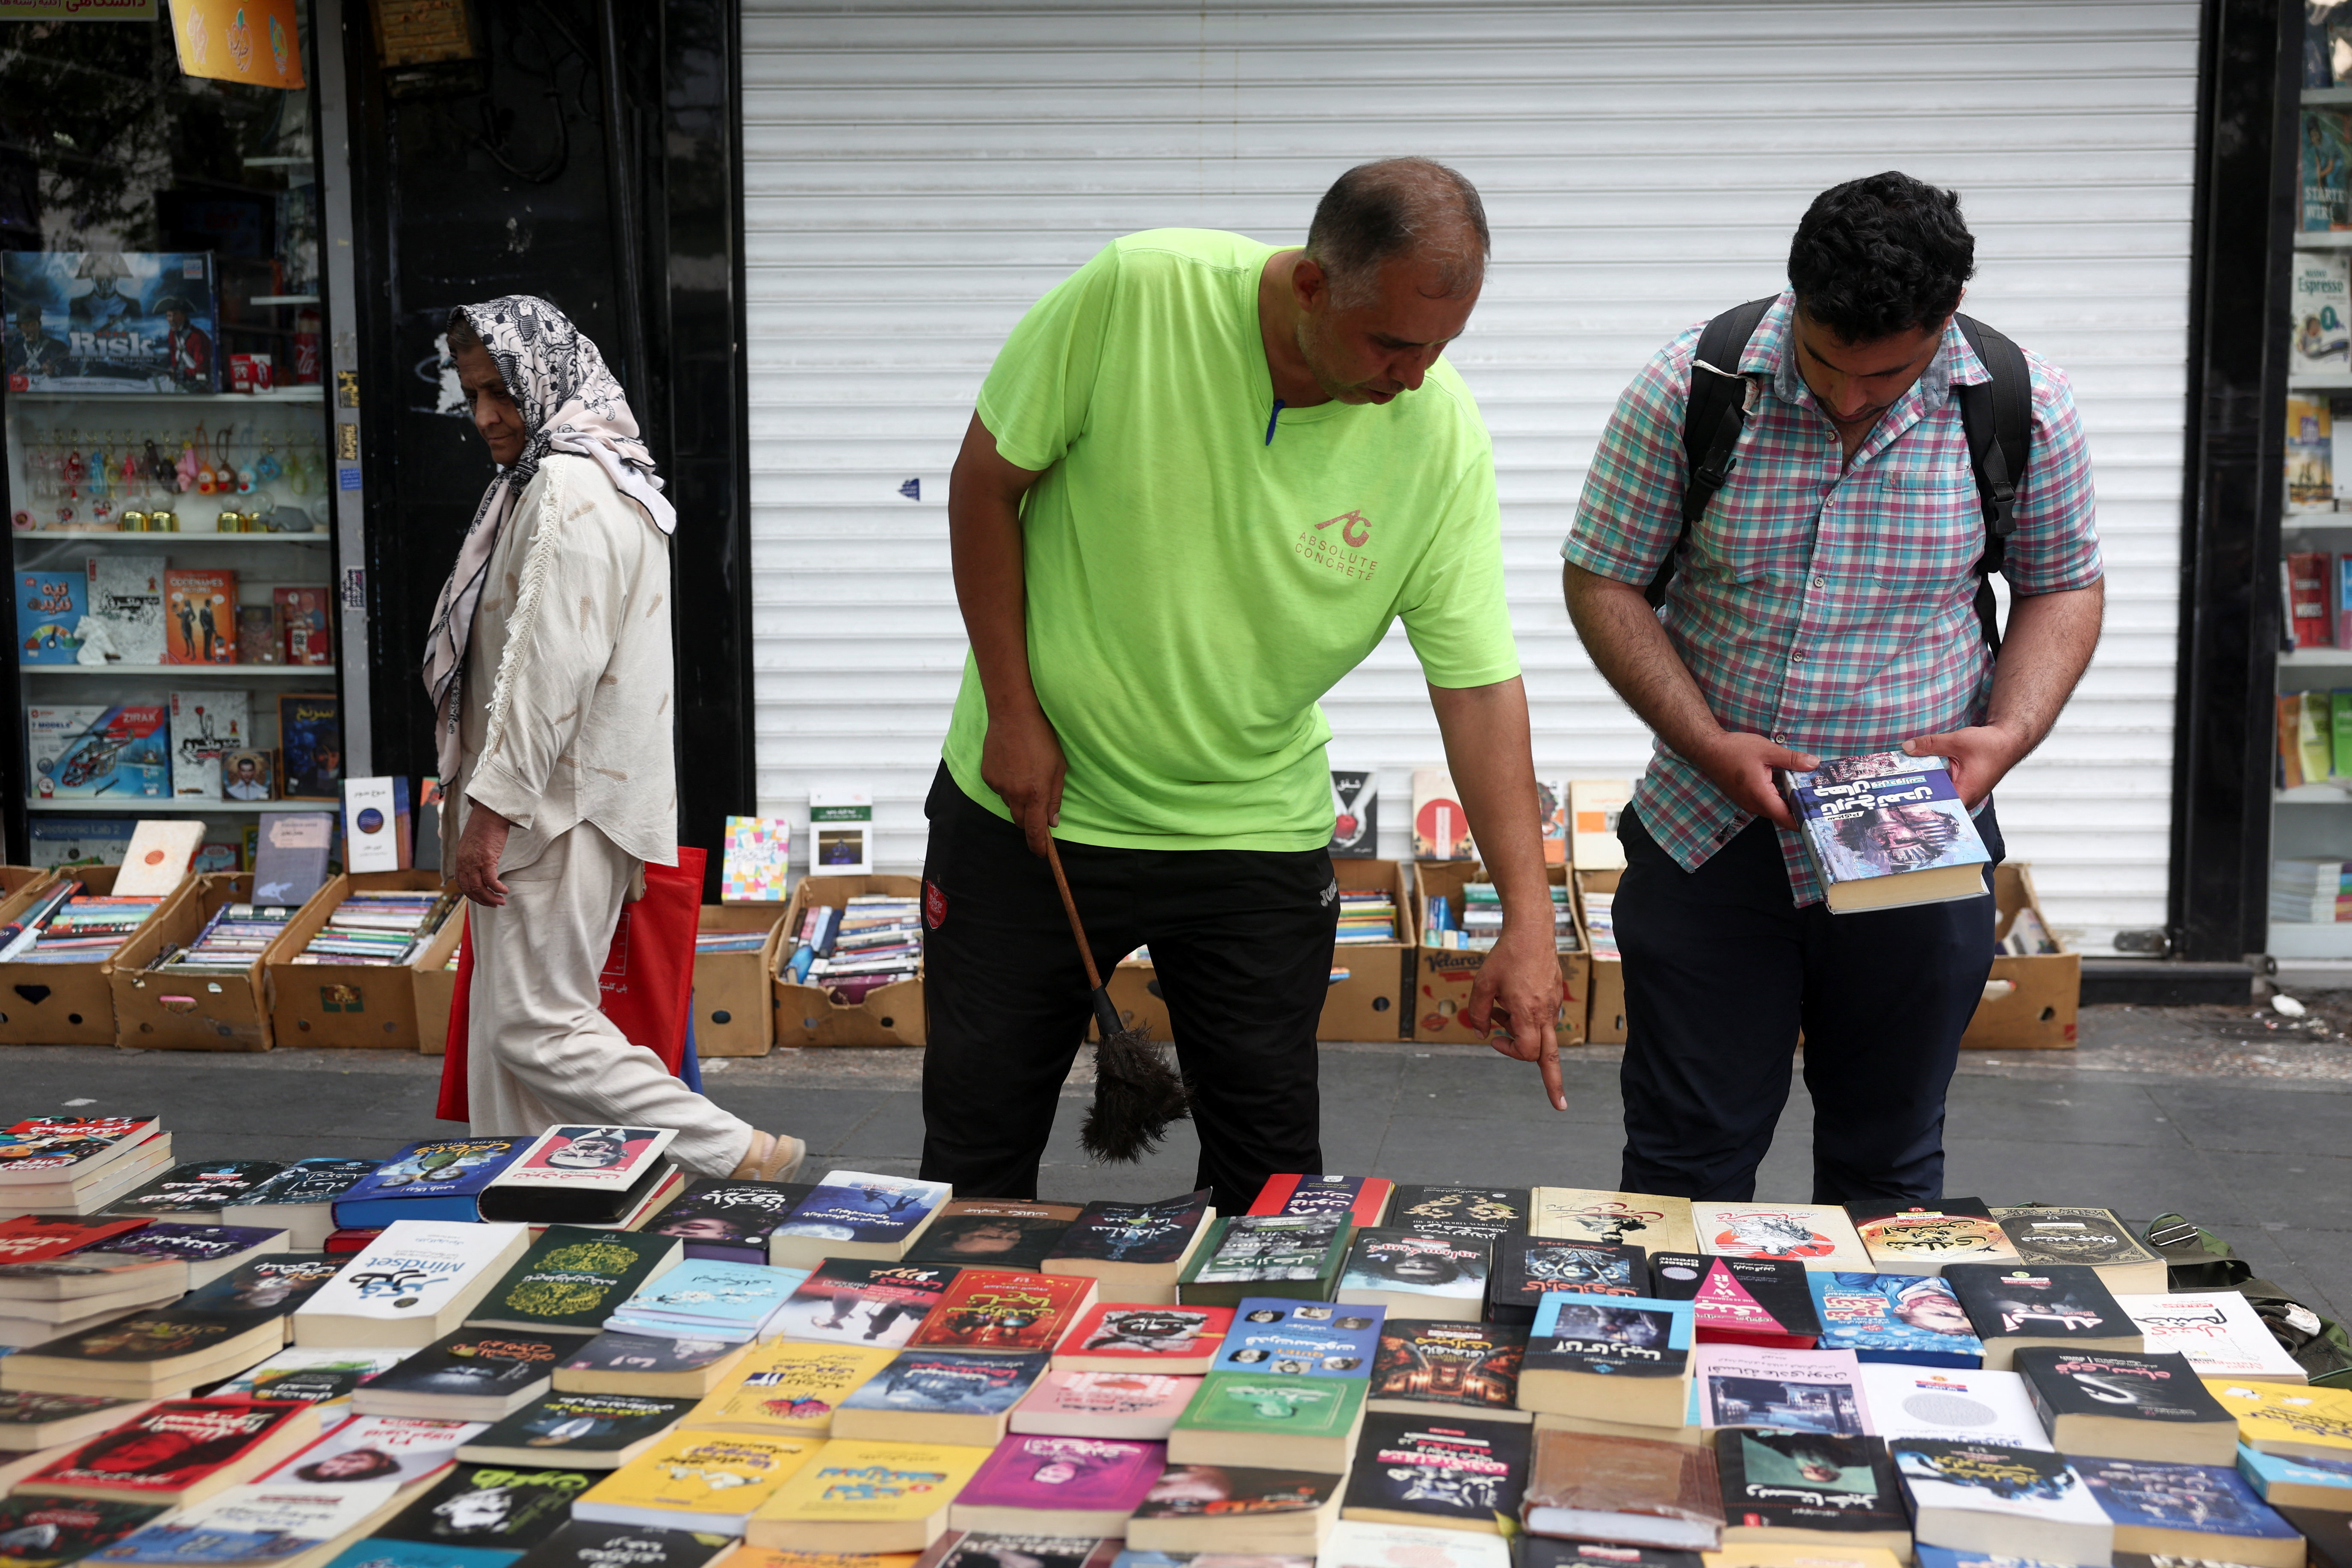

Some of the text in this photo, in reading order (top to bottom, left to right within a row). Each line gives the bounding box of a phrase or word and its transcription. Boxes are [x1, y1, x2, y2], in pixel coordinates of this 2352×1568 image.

[2299, 277, 2343, 296] Espresso
[68, 331, 155, 357] Risk
[1299, 532, 1378, 570] ABSOLUTE
[1295, 543, 1374, 581] CONCRETE
[170, 577, 224, 588] CODENAMES
[1813, 780, 1870, 797] جهان
[1820, 786, 1933, 816] تاریخ تمدن
[701, 1189, 786, 1212] بلادونا
[1289, 1198, 1351, 1206] قانون
[1294, 1190, 1355, 1199] قدرت
[1879, 1220, 1977, 1237] آهنین
[365, 1257, 466, 1273] Mindset
[1273, 1255, 1316, 1265] کل
[1520, 1279, 1637, 1297] کارامازوف
[945, 1305, 1056, 1318] سوزاندن
[1694, 1301, 1762, 1317] جنگ
[1825, 1297, 1886, 1310] زندگی
[1826, 1308, 1882, 1320] شور
[2131, 1308, 2228, 1327] خشم
[2150, 1324, 2226, 1337] کنترل
[1245, 1335, 1357, 1352] قدرت سکوت
[1415, 1336, 1493, 1349] میراث
[1550, 1340, 1661, 1361] آنا کارنینا
[1274, 1348, 1325, 1358] QUIET
[1419, 1345, 1485, 1358] بازی‌های
[1764, 1368, 1805, 1378] عادی
[1808, 1371, 1847, 1382] بودن
[2111, 1367, 2171, 1381] سیاه
[1746, 1483, 1880, 1509] رستاخیز
